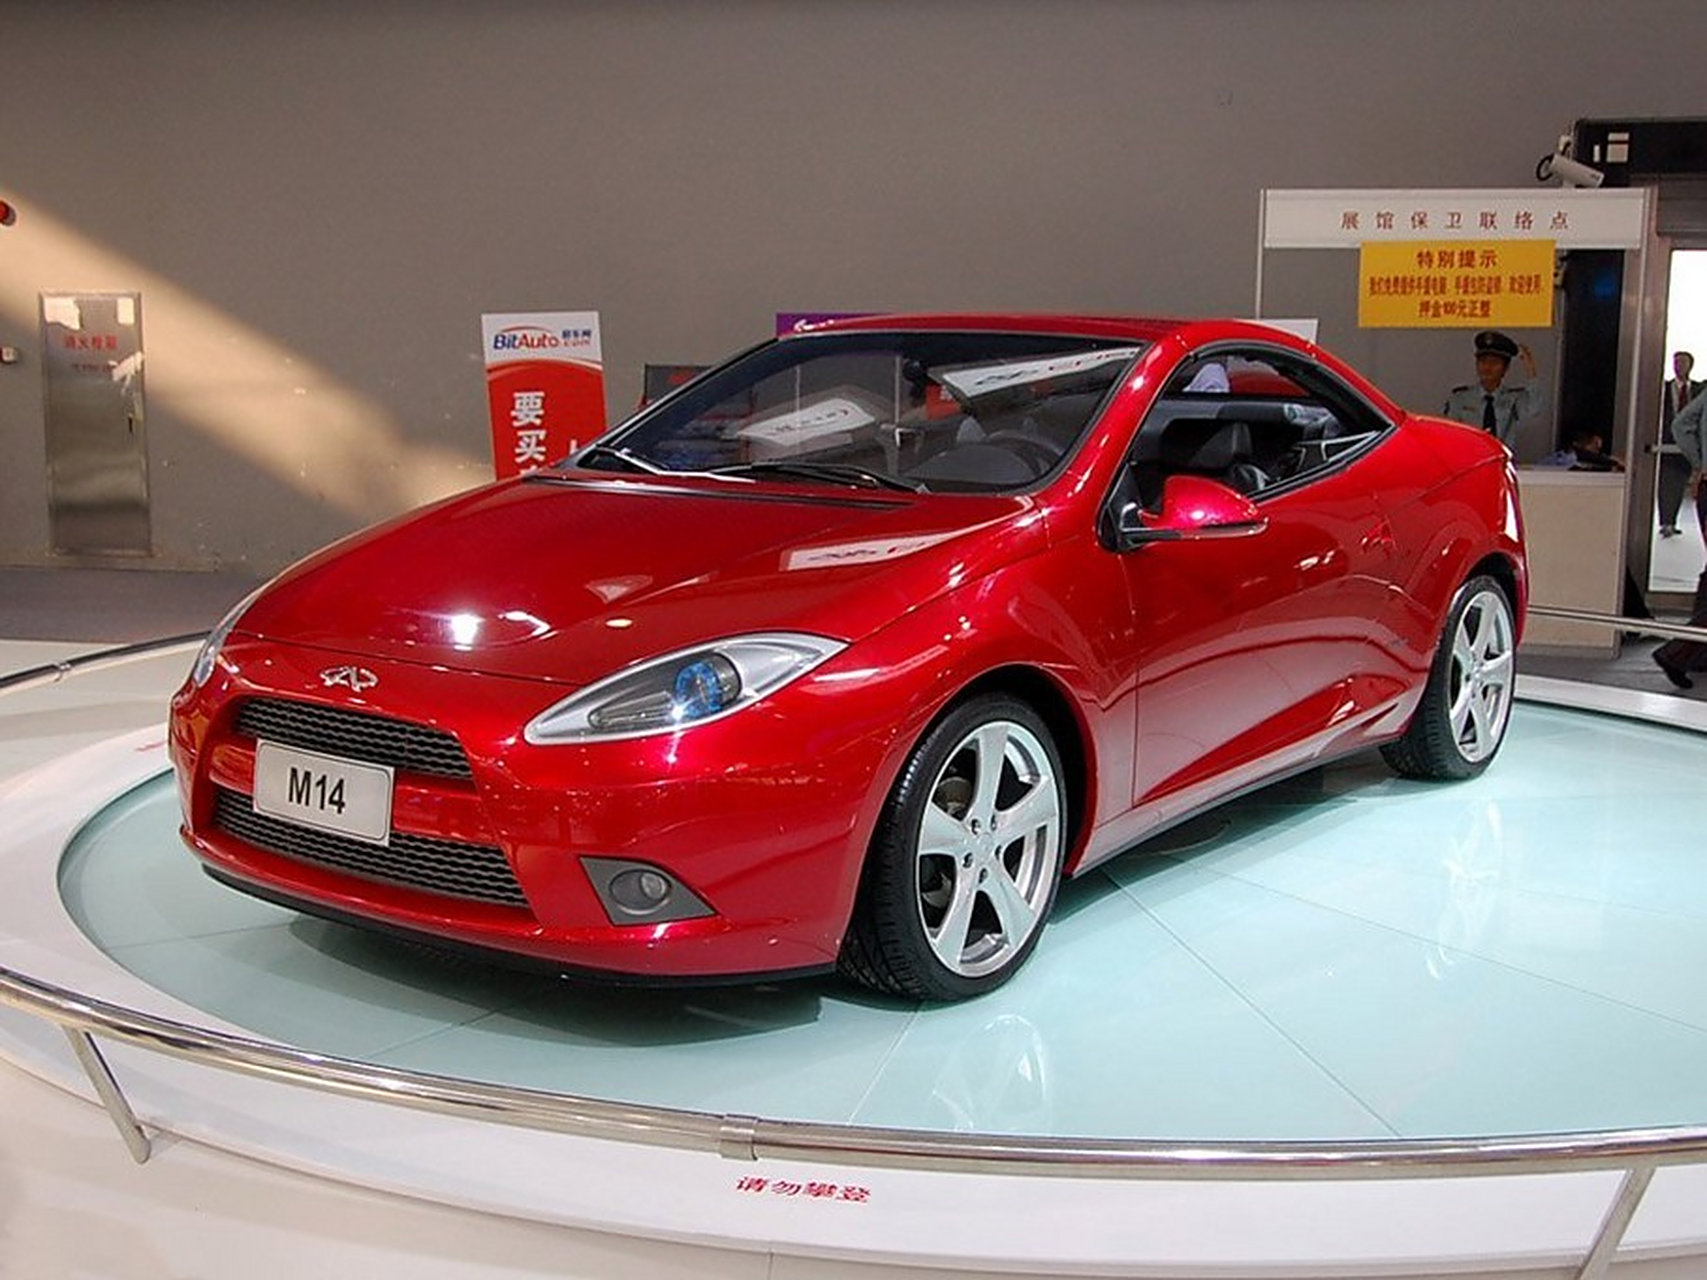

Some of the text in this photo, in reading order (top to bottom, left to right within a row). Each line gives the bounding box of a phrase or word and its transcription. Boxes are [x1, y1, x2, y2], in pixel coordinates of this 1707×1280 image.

[1341, 211, 1570, 231] 展馆保卫联络点
[1417, 249, 1498, 269] 特别提示
[493, 333, 559, 350] BitAuto
[288, 767, 346, 814] M14
[736, 1176, 872, 1203] 请勿攀登
